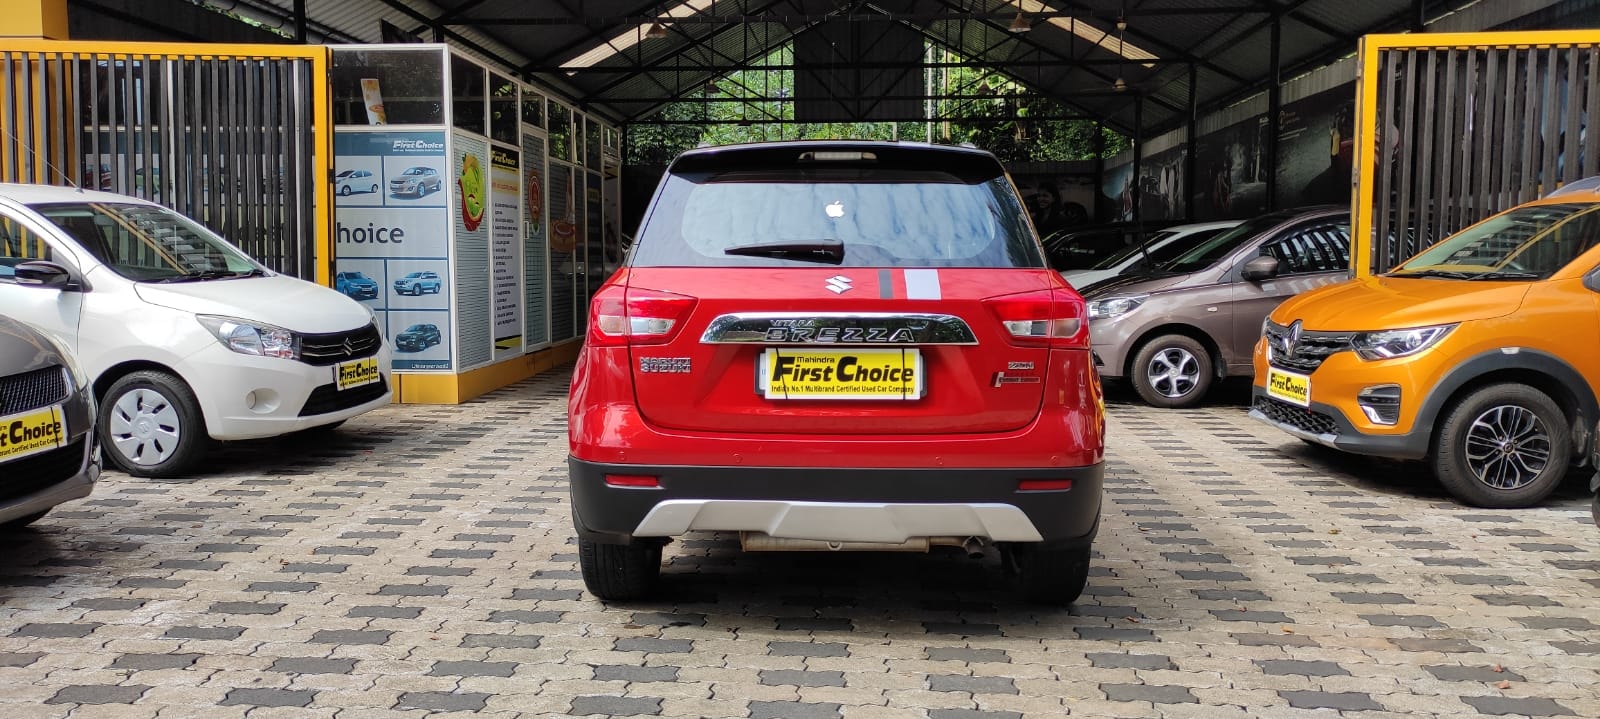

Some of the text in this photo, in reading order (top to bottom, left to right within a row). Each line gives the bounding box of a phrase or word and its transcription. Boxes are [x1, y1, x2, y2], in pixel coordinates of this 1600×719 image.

[393, 140, 415, 149] First
[415, 140, 444, 149] Choice
[336, 222, 405, 244] hoice
[765, 327, 915, 342] BREZZA
[796, 356, 835, 364] Mahindra
[339, 366, 355, 382] First
[772, 356, 914, 383] First Choice
[805, 385, 835, 393] Multibrand
[836, 385, 861, 393] Certified
[861, 385, 876, 393] Used
[877, 385, 887, 393] Car
[1270, 373, 1285, 390] First
[1285, 376, 1307, 396] Choice
[9, 420, 61, 445] Choice
